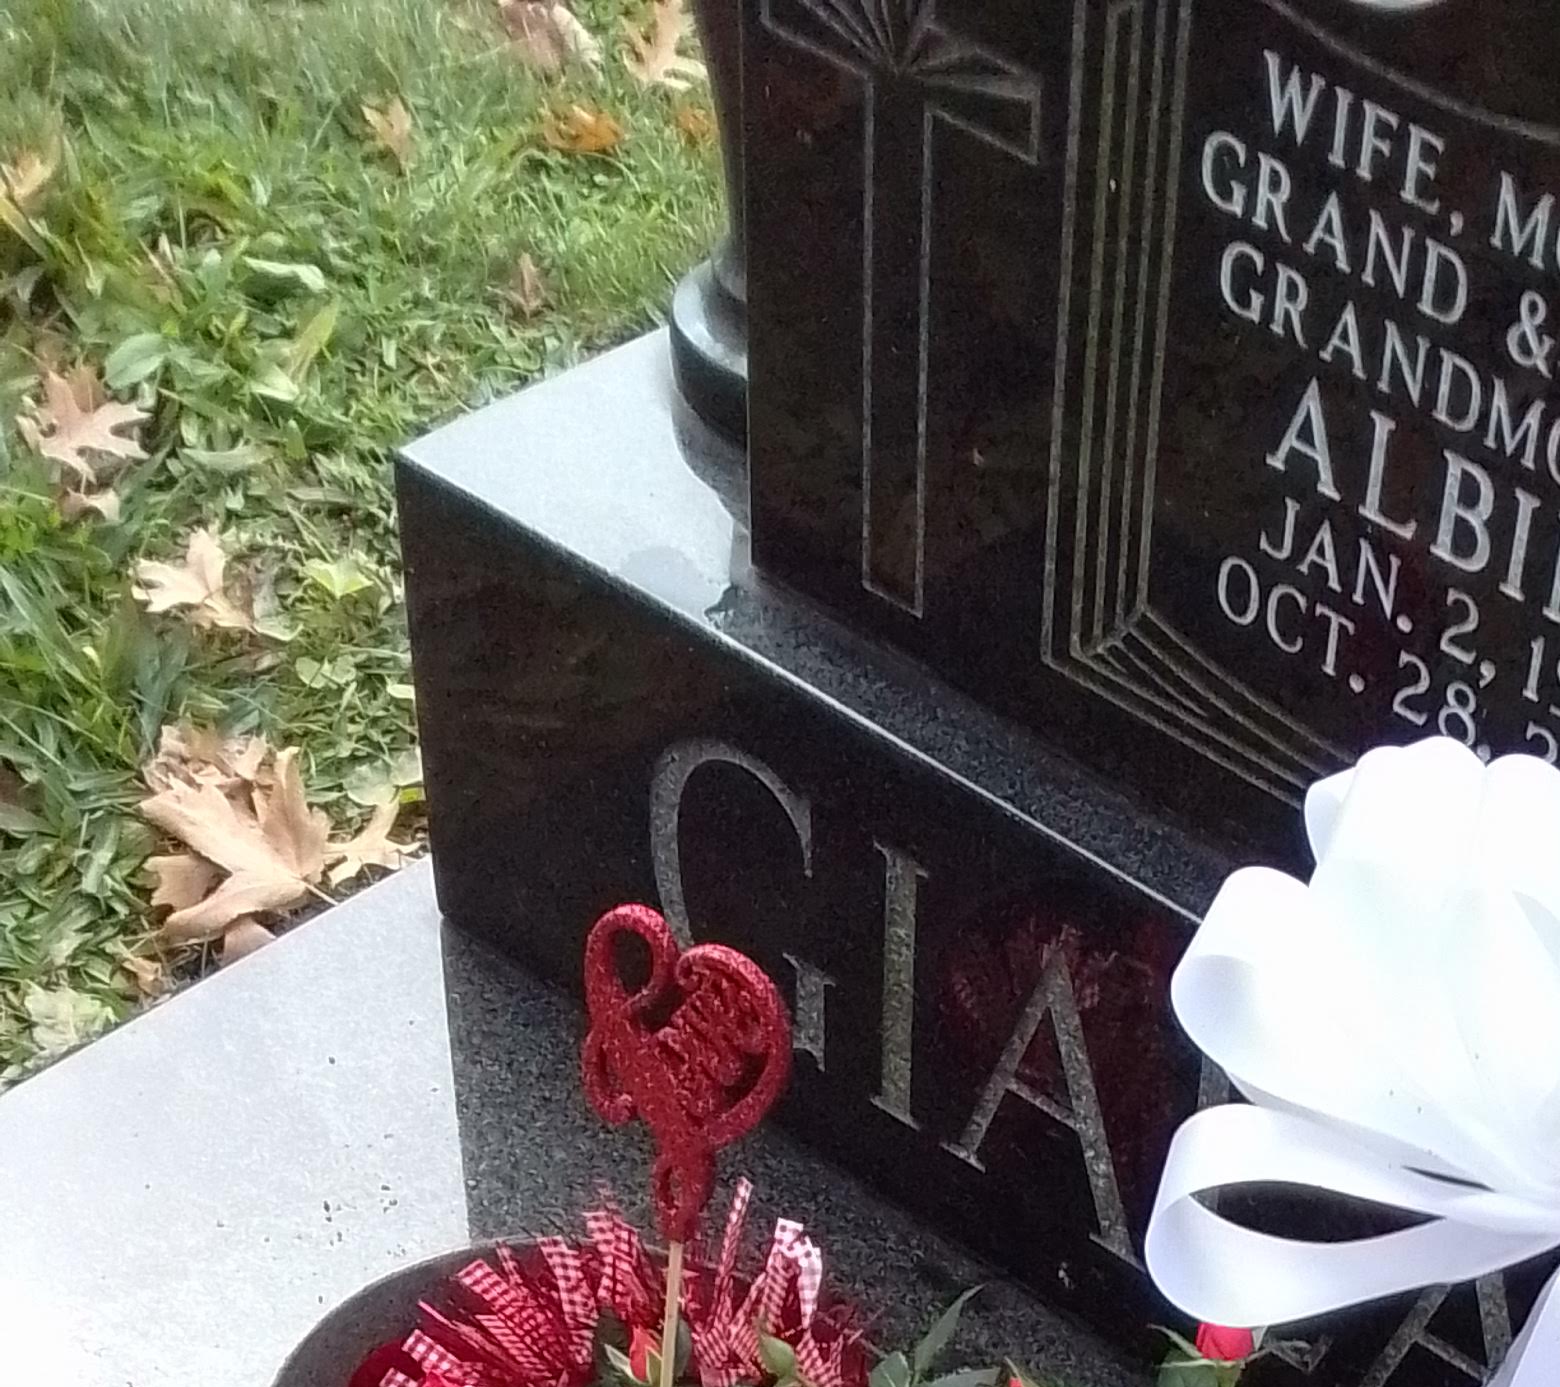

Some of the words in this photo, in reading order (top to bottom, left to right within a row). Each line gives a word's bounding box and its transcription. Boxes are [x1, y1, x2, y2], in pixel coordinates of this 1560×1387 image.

[1264, 49, 1465, 237] WIFE,
[1202, 130, 1468, 326] GRAND
[1508, 290, 1552, 378] &
[1216, 556, 1365, 694] OCT.
[1261, 498, 1413, 634] JAN.
[1440, 588, 1496, 689] 2,
